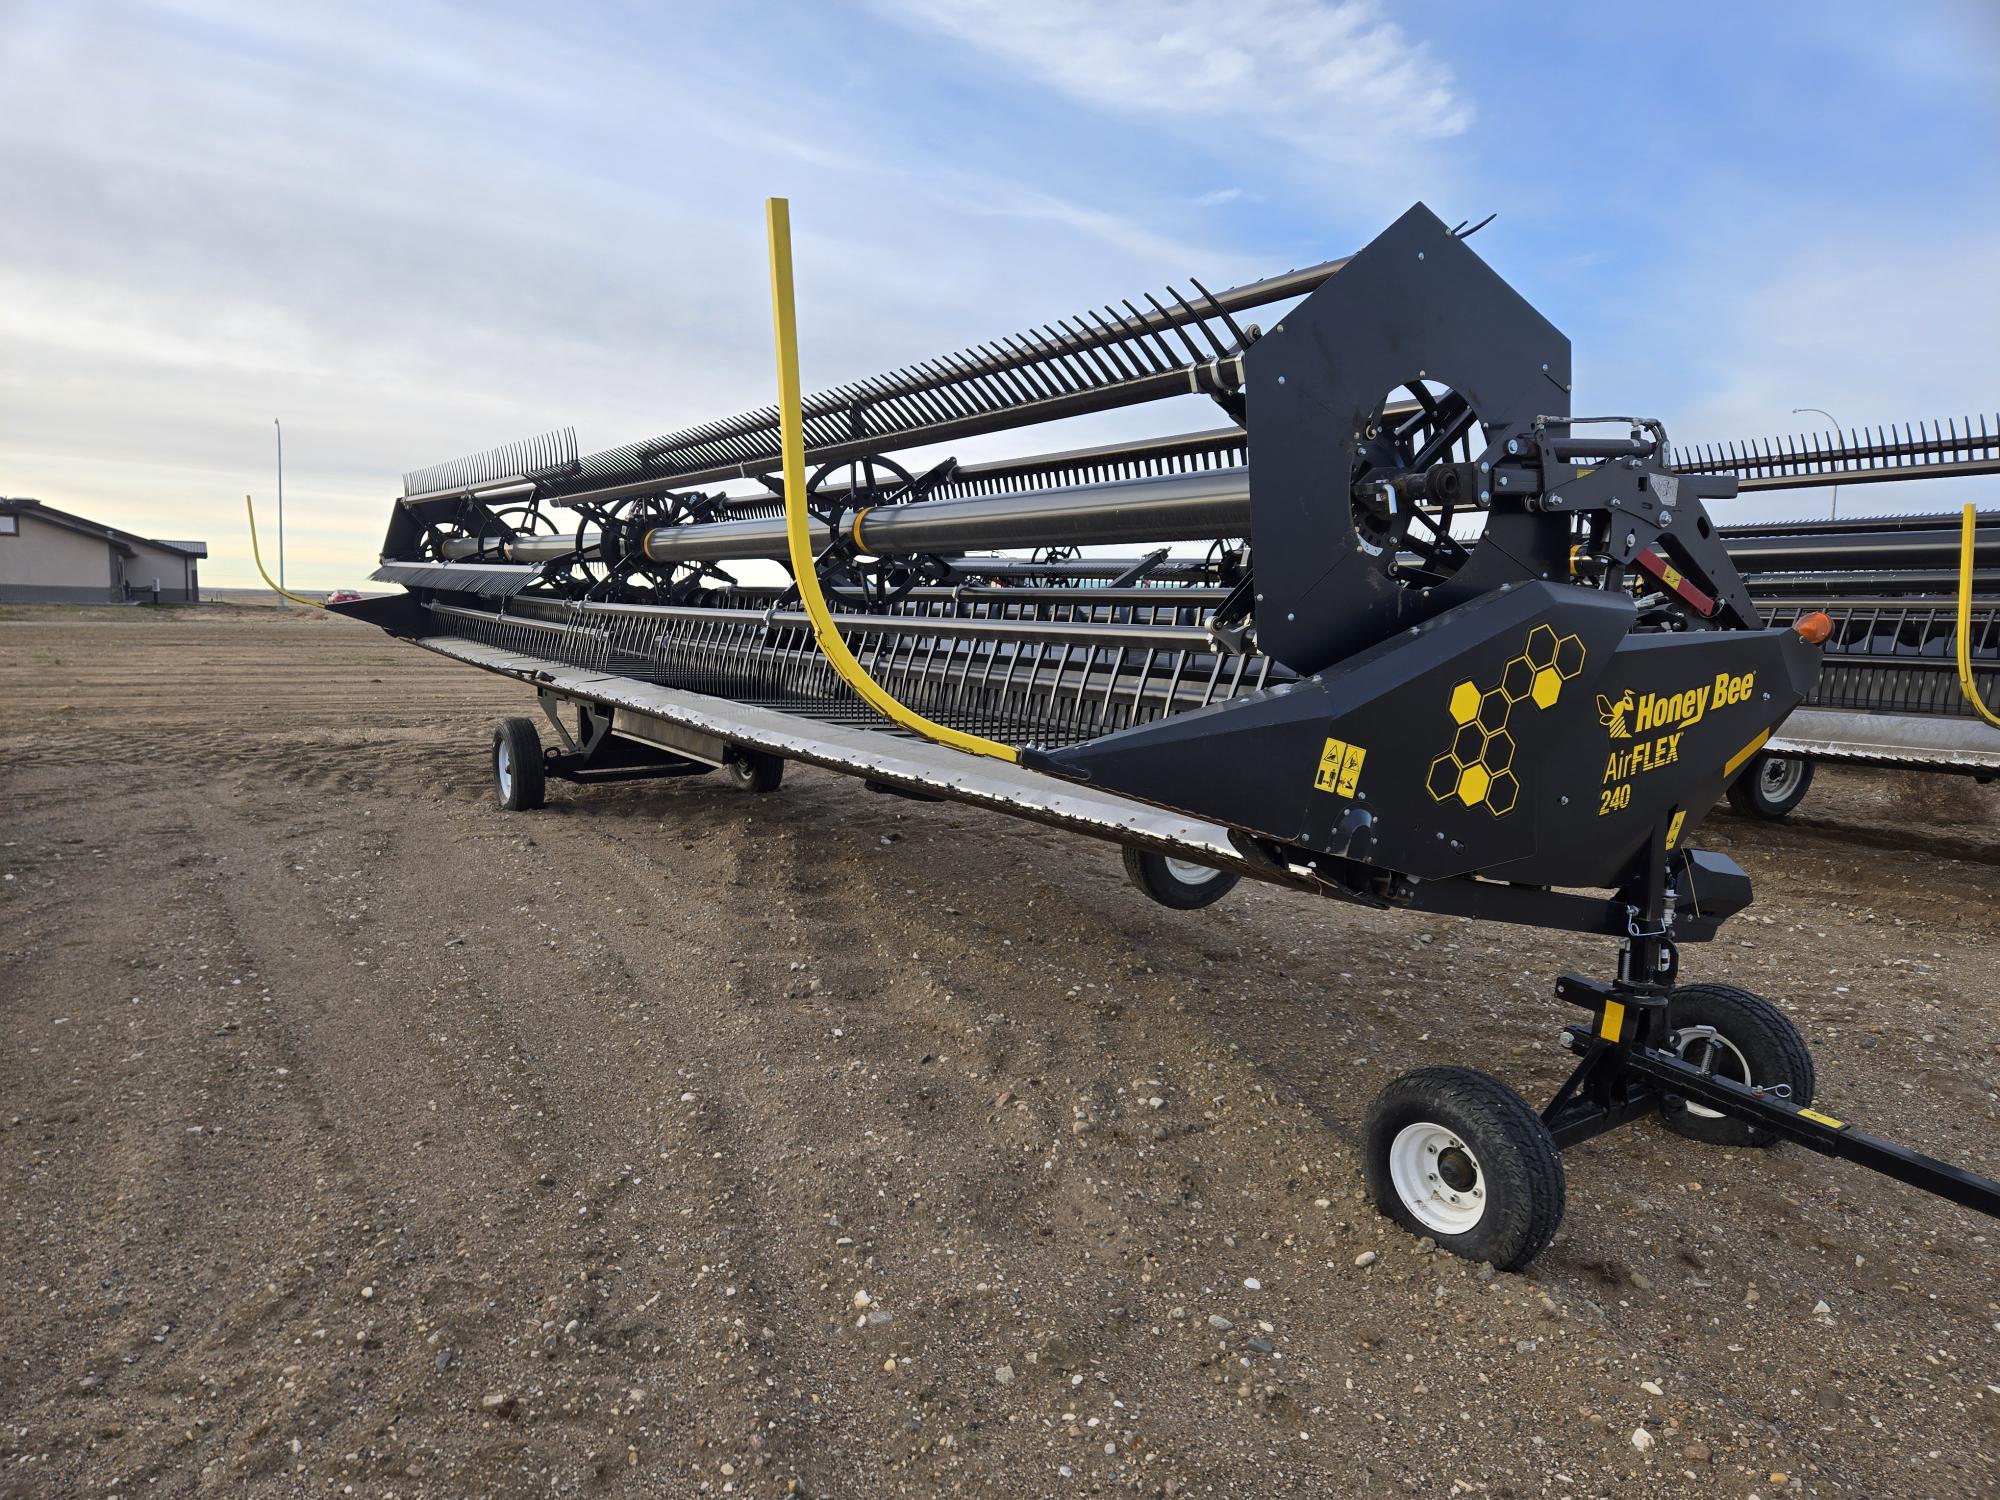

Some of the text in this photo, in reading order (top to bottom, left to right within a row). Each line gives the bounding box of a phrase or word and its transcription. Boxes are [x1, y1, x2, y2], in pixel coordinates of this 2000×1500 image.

[1635, 672, 1754, 732] Honey Bee
[1602, 732, 1682, 784] AirFLEX
[1599, 784, 1631, 816] 240
